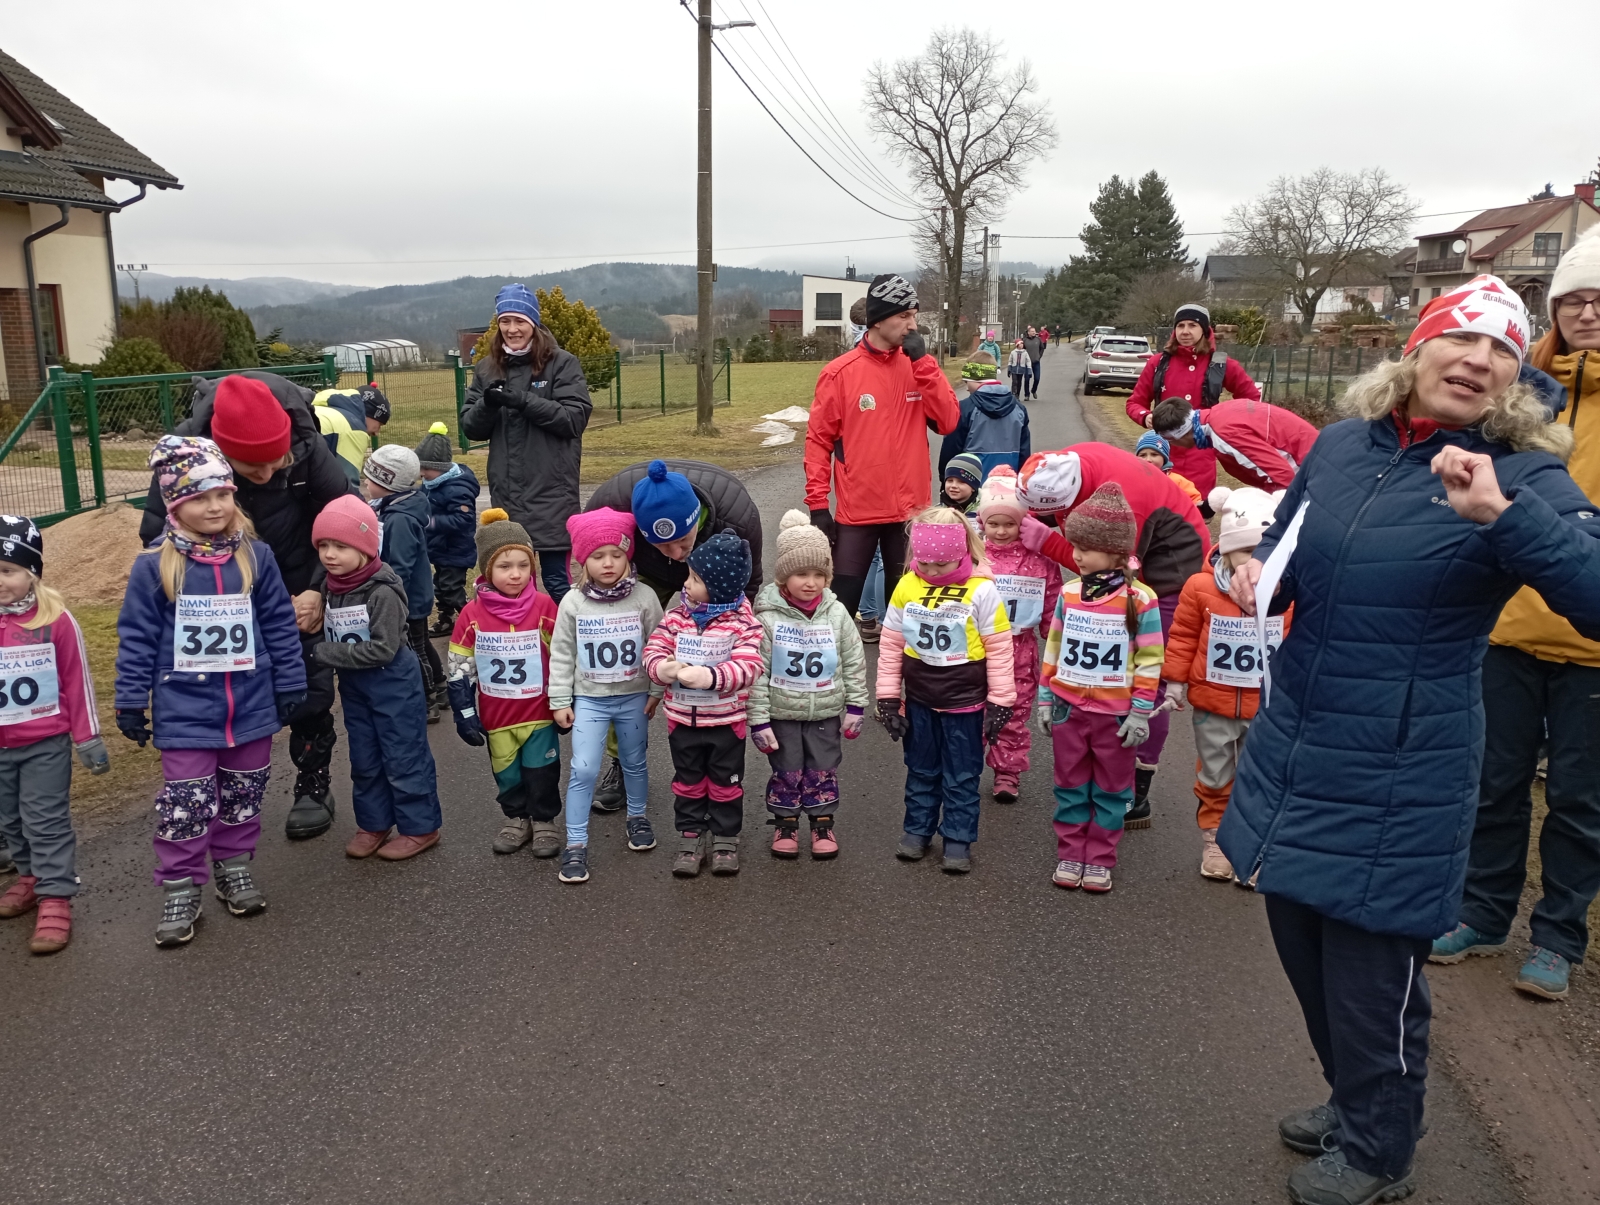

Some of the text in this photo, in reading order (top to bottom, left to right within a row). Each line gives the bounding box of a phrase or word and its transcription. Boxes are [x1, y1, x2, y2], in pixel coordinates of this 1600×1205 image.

[996, 577, 1012, 585] MNÍ
[577, 617, 604, 627] ZIMNÍ
[1067, 613, 1092, 625] ZIMNÍ
[1213, 617, 1242, 629] ZIMNÍ
[620, 624, 640, 632] LIGA
[776, 624, 804, 637] ZIMNÍ
[181, 623, 248, 656] 329
[476, 635, 502, 644] ZIMNÍ
[678, 637, 702, 647] ZIMNÍ
[816, 637, 833, 645] LIGA
[916, 623, 951, 651] 56
[518, 643, 538, 651] LIGA
[584, 639, 637, 668] 108
[1064, 637, 1123, 671] 354
[25, 657, 52, 667] LIGA
[785, 650, 824, 678] 36
[490, 658, 527, 685] 23
